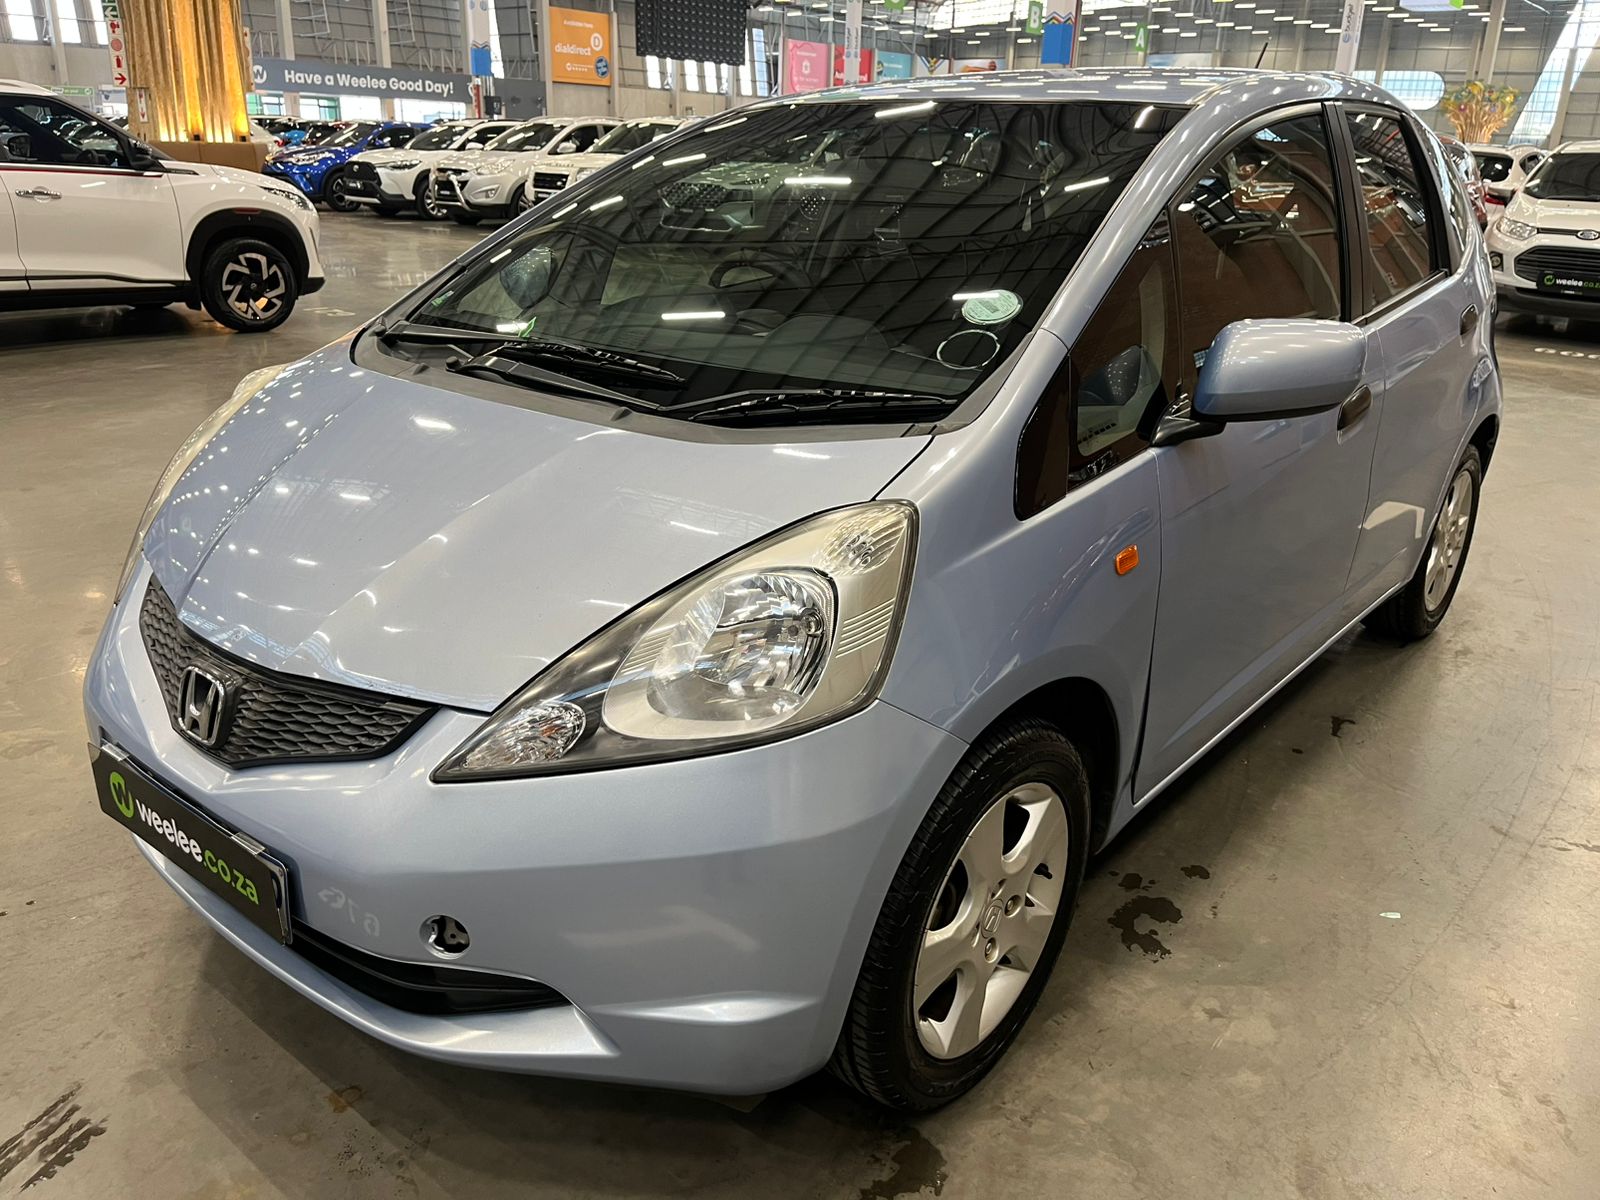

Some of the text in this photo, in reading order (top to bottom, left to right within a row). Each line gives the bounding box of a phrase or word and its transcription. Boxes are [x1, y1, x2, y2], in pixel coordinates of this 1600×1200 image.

[1030, 5, 1041, 28] B
[1136, 28, 1145, 48] A
[285, 69, 454, 98] Have a Weelee Good Day!
[135, 798, 259, 905] weelee.co.za
